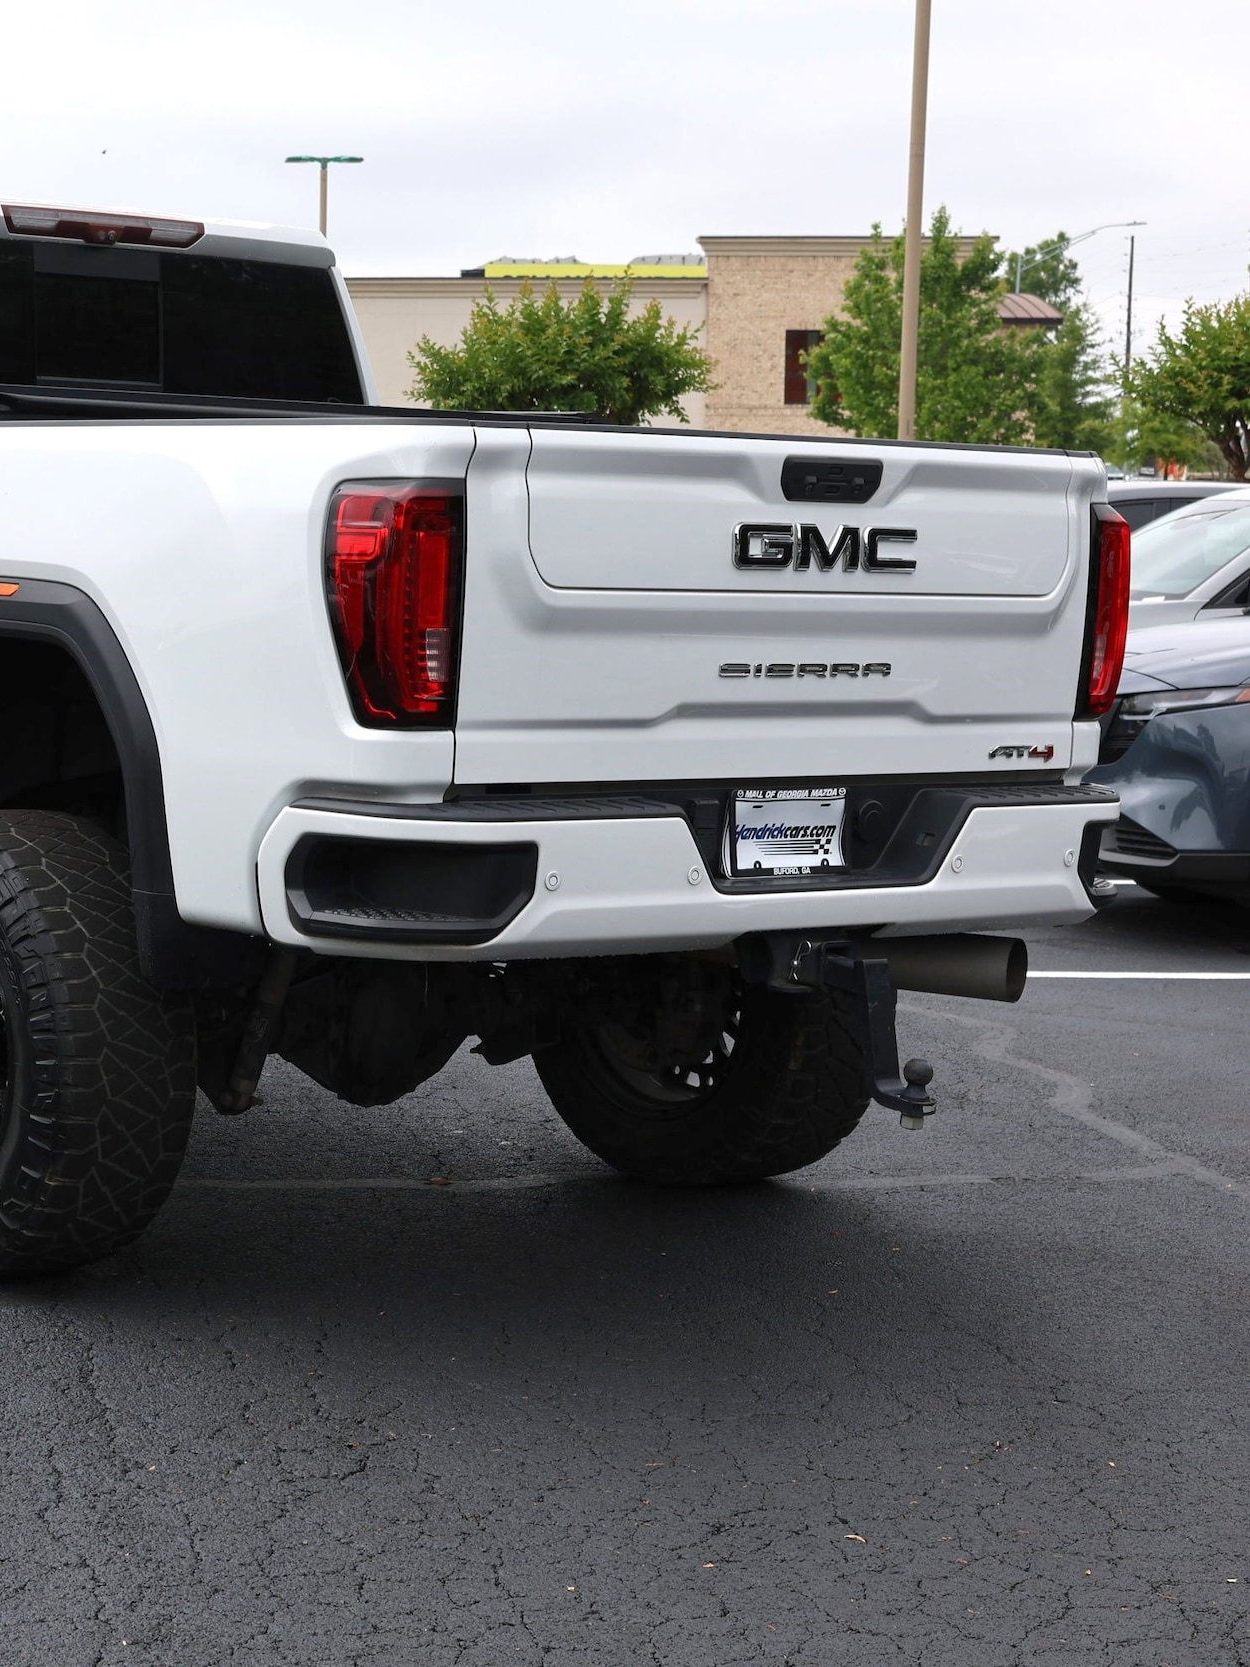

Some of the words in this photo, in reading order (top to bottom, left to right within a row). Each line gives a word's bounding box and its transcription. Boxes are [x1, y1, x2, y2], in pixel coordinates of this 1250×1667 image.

[732, 522, 919, 574] GMC
[718, 662, 892, 678] SIERRA
[988, 744, 1054, 763] AT4
[744, 790, 763, 798] MALL
[765, 790, 776, 798] OF
[777, 789, 809, 799] GEORGIA
[810, 788, 838, 798] MAZDA
